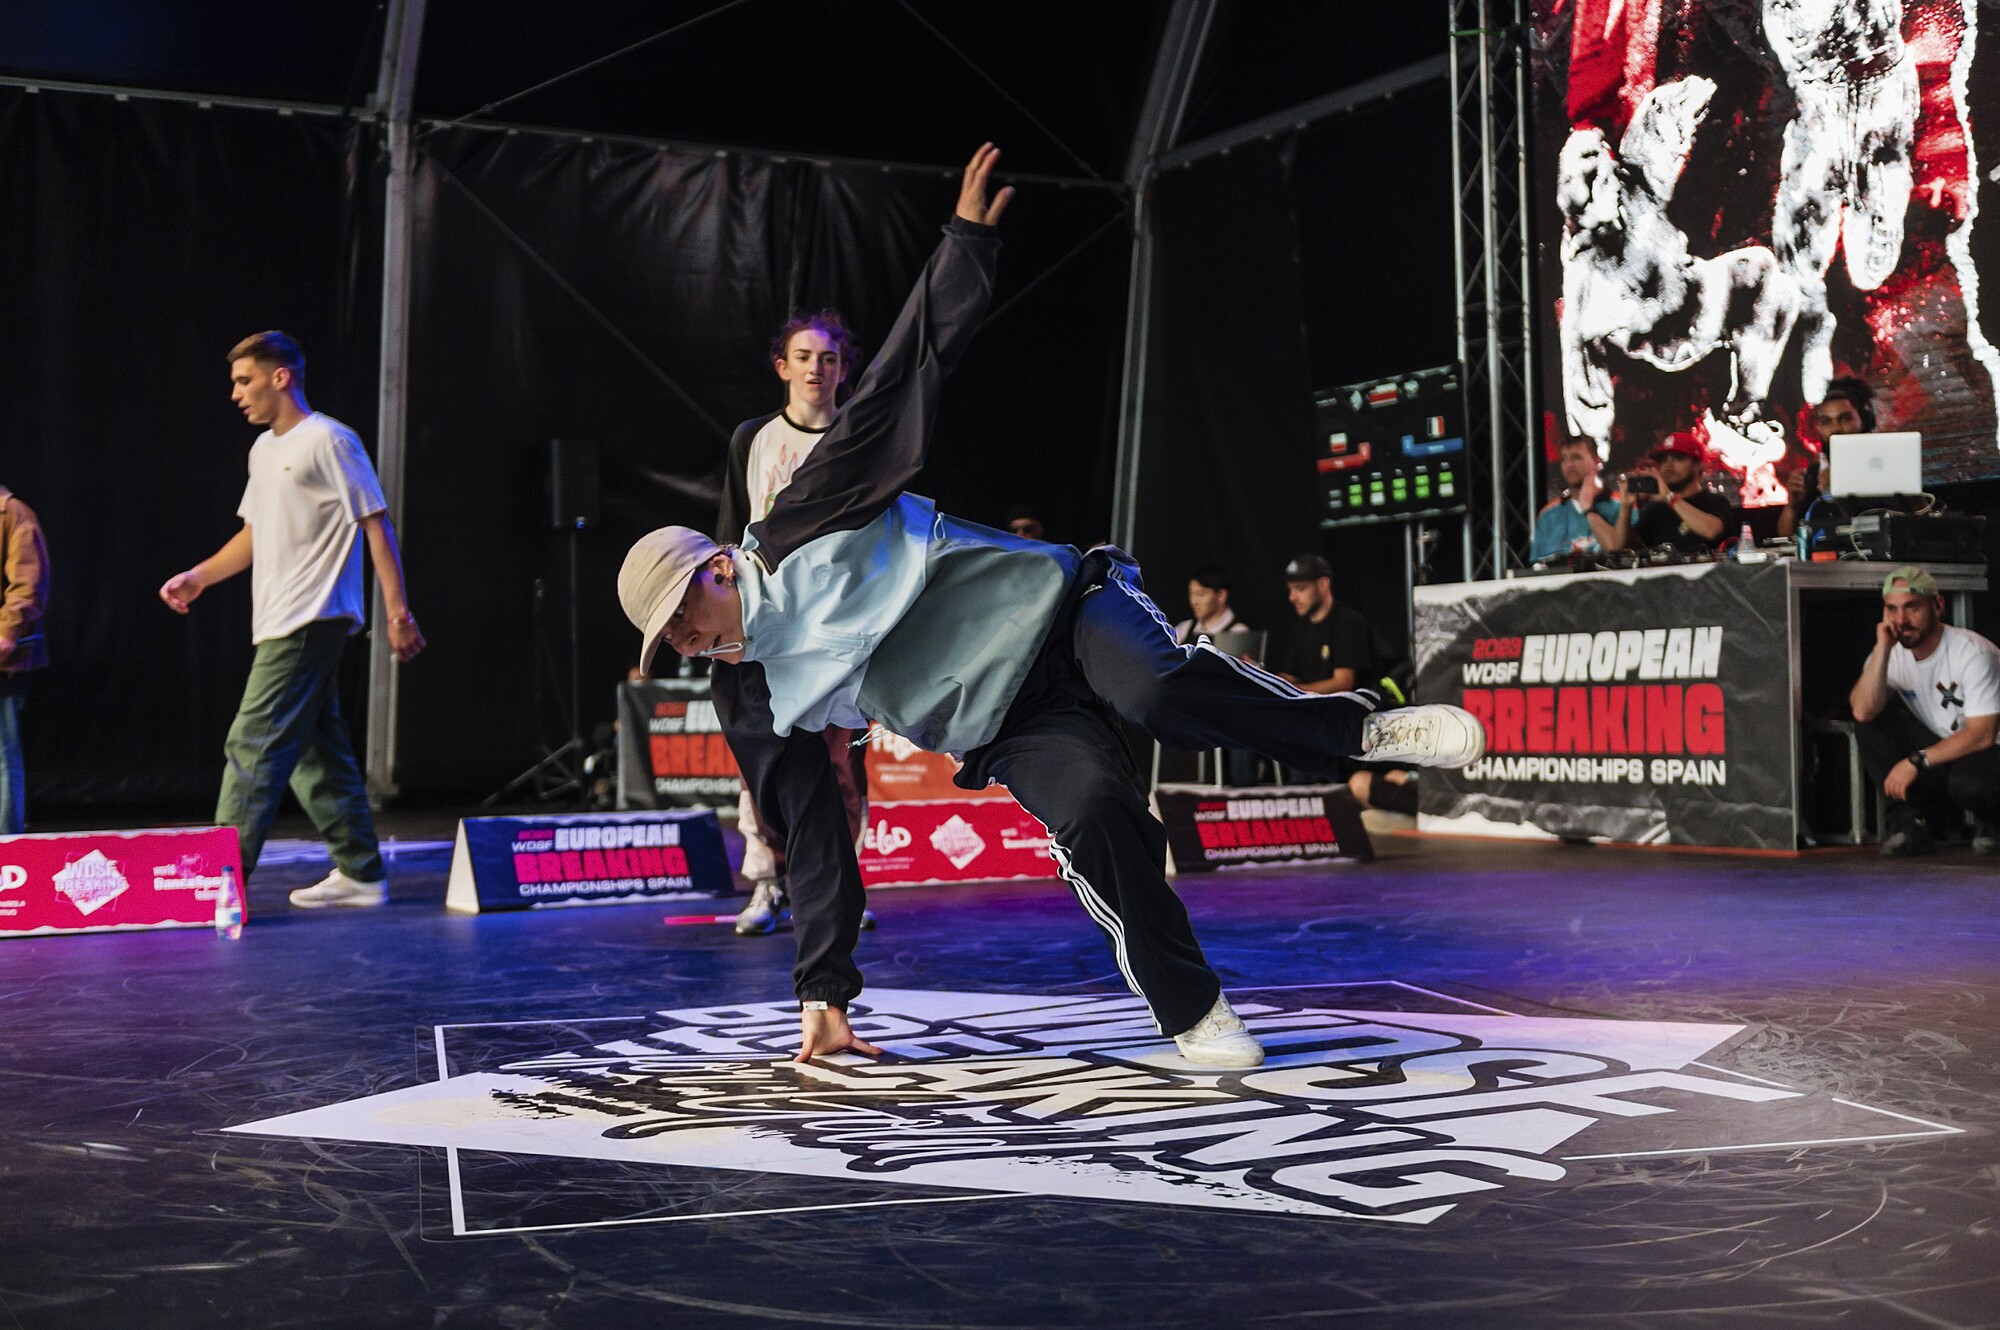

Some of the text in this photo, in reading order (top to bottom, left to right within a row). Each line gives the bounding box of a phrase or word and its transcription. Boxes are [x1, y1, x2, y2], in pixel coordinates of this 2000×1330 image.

[1463, 626, 1723, 685] WDSF EUROPEAN
[1472, 636, 1522, 660] 2023
[1651, 760, 1726, 786] SPAIN
[1227, 797, 1325, 820] EUROPEAN
[512, 840, 553, 852] WDSF
[555, 823, 680, 850] EUROPEAN
[1197, 817, 1336, 849] BREAKING
[1204, 842, 1339, 860] CHAMPIONSHIPS SPAIN
[514, 847, 689, 883] BREAKING
[519, 876, 692, 896] CHAMPIONSHIPS SPAIN
